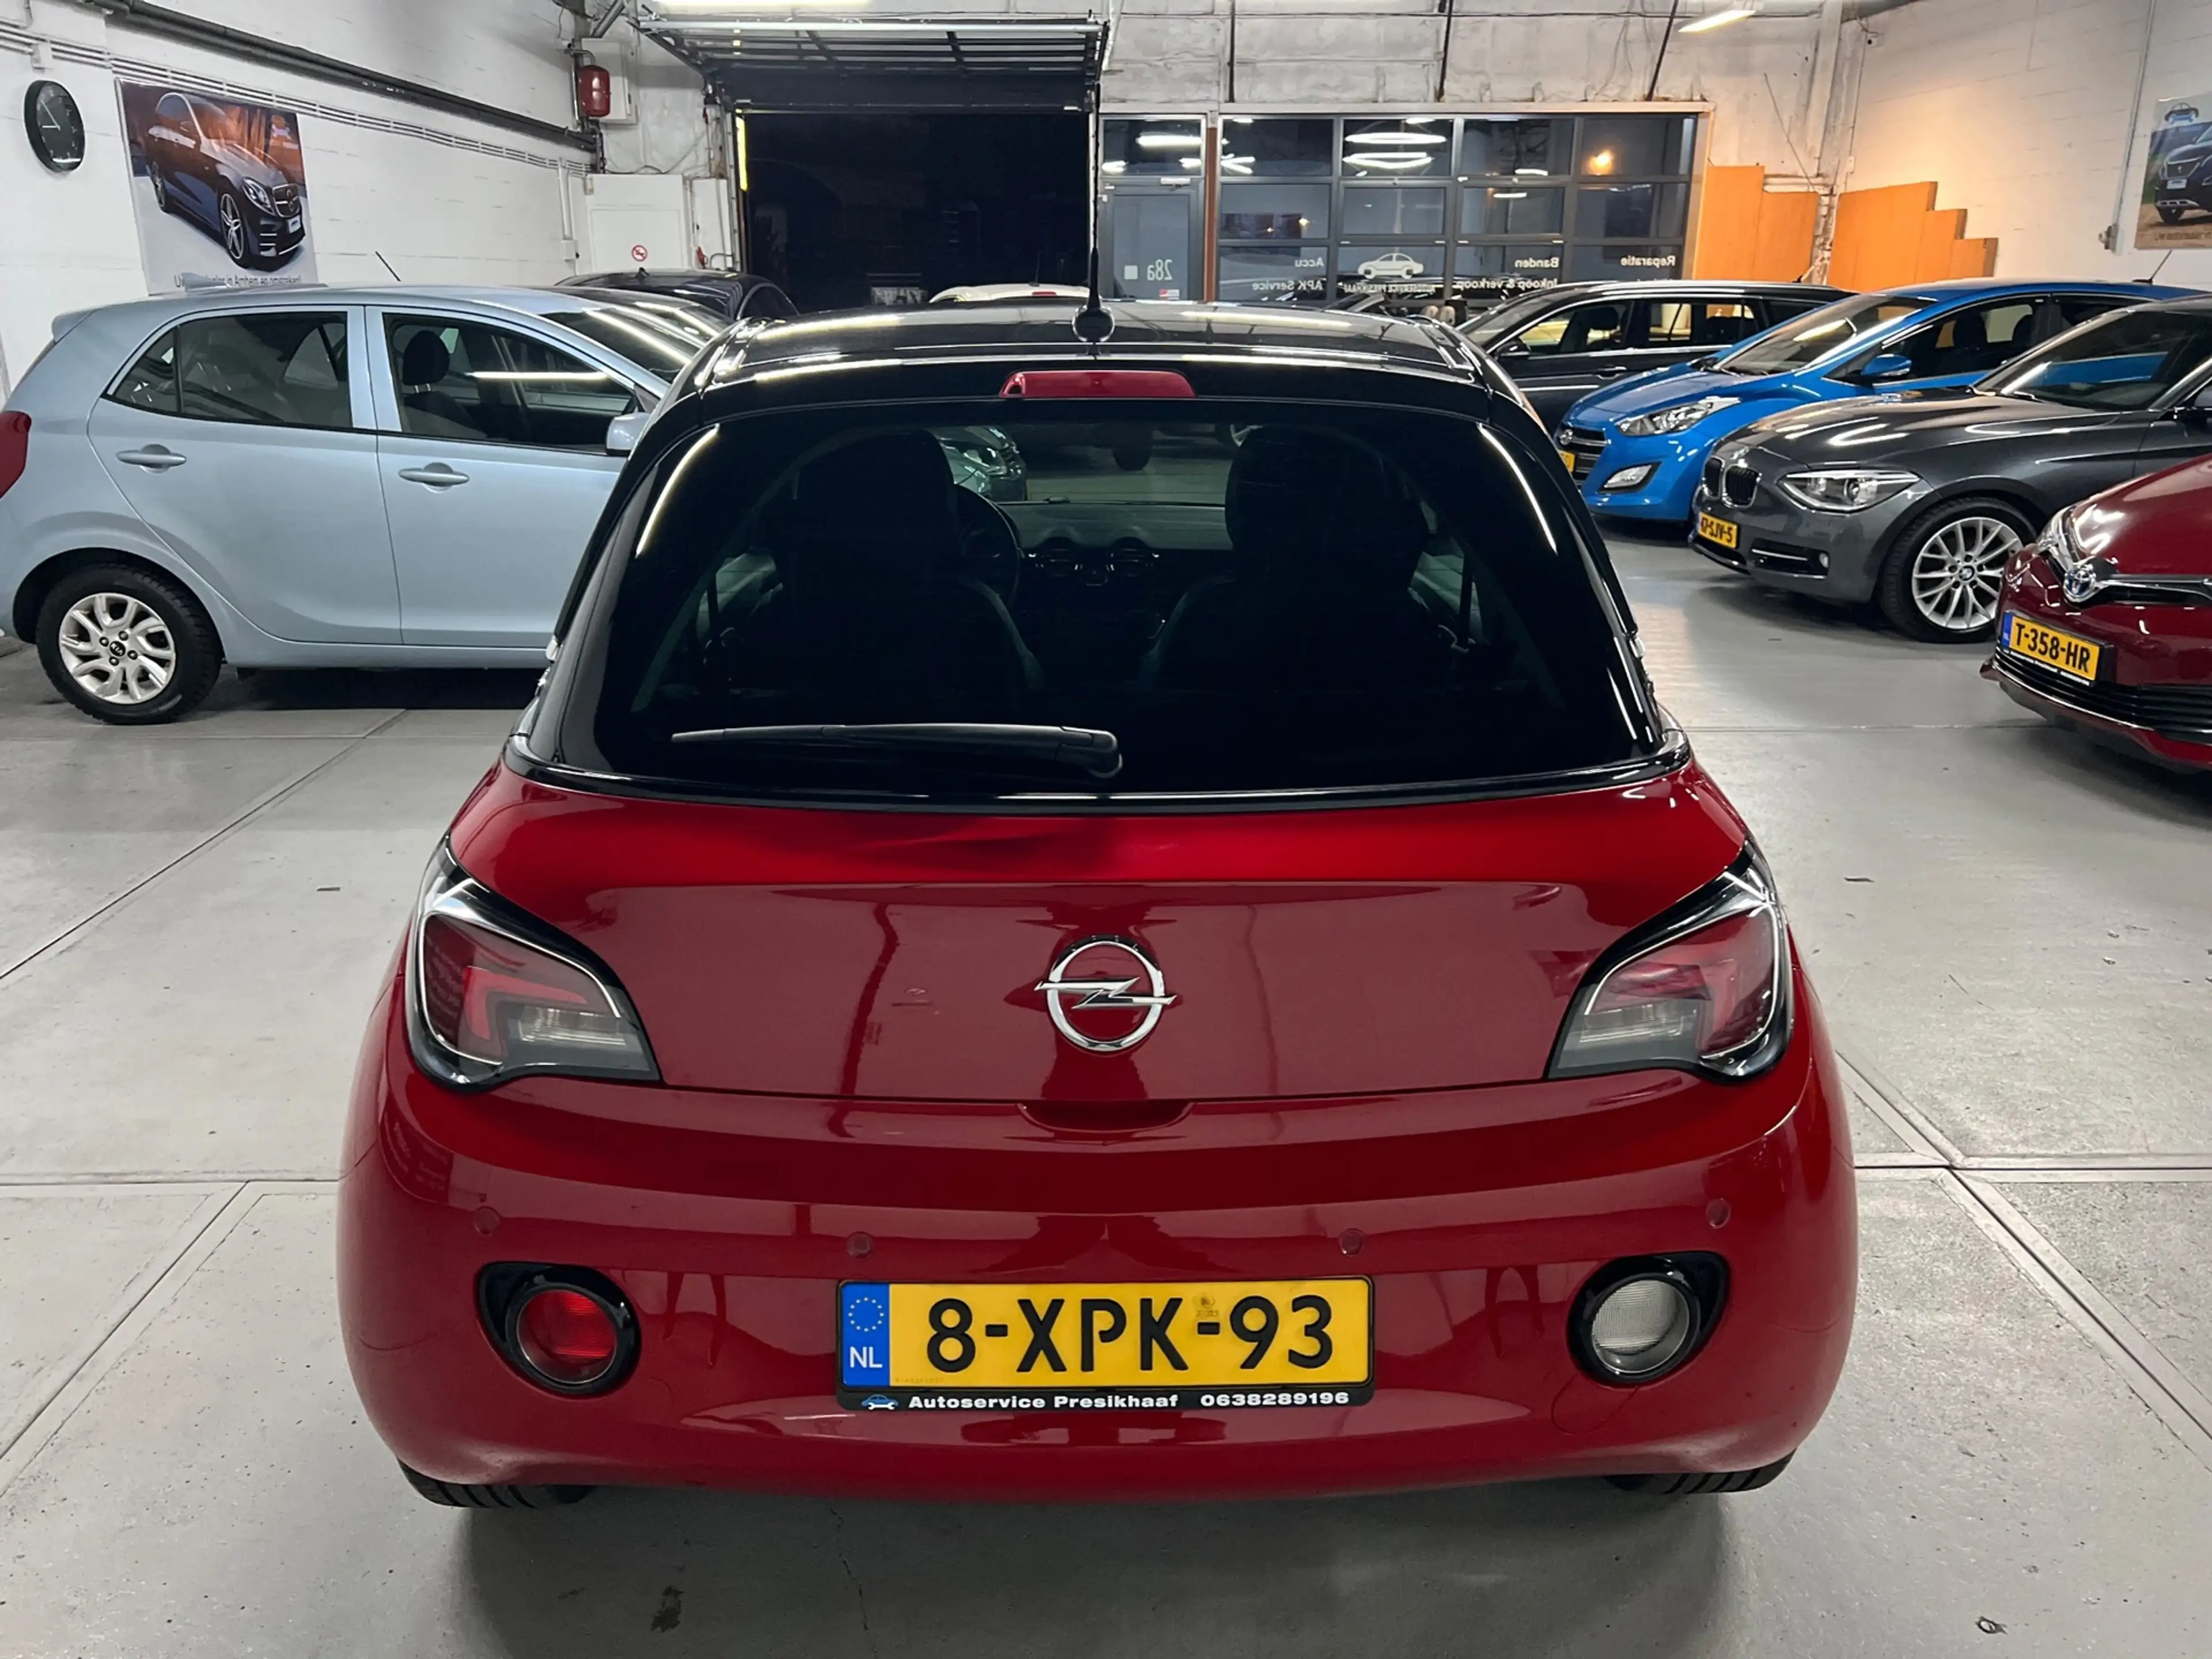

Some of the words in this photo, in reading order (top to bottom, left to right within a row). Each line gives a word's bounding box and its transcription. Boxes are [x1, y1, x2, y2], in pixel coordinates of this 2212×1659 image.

[2016, 622, 2090, 673] T-358-HR
[926, 1295, 1334, 1373] 8-XPK-93
[850, 1346, 883, 1369] NL
[908, 1395, 1046, 1409] Autoservice
[1054, 1394, 1179, 1409] Presikhaaf
[1200, 1392, 1350, 1407] 0638289196
